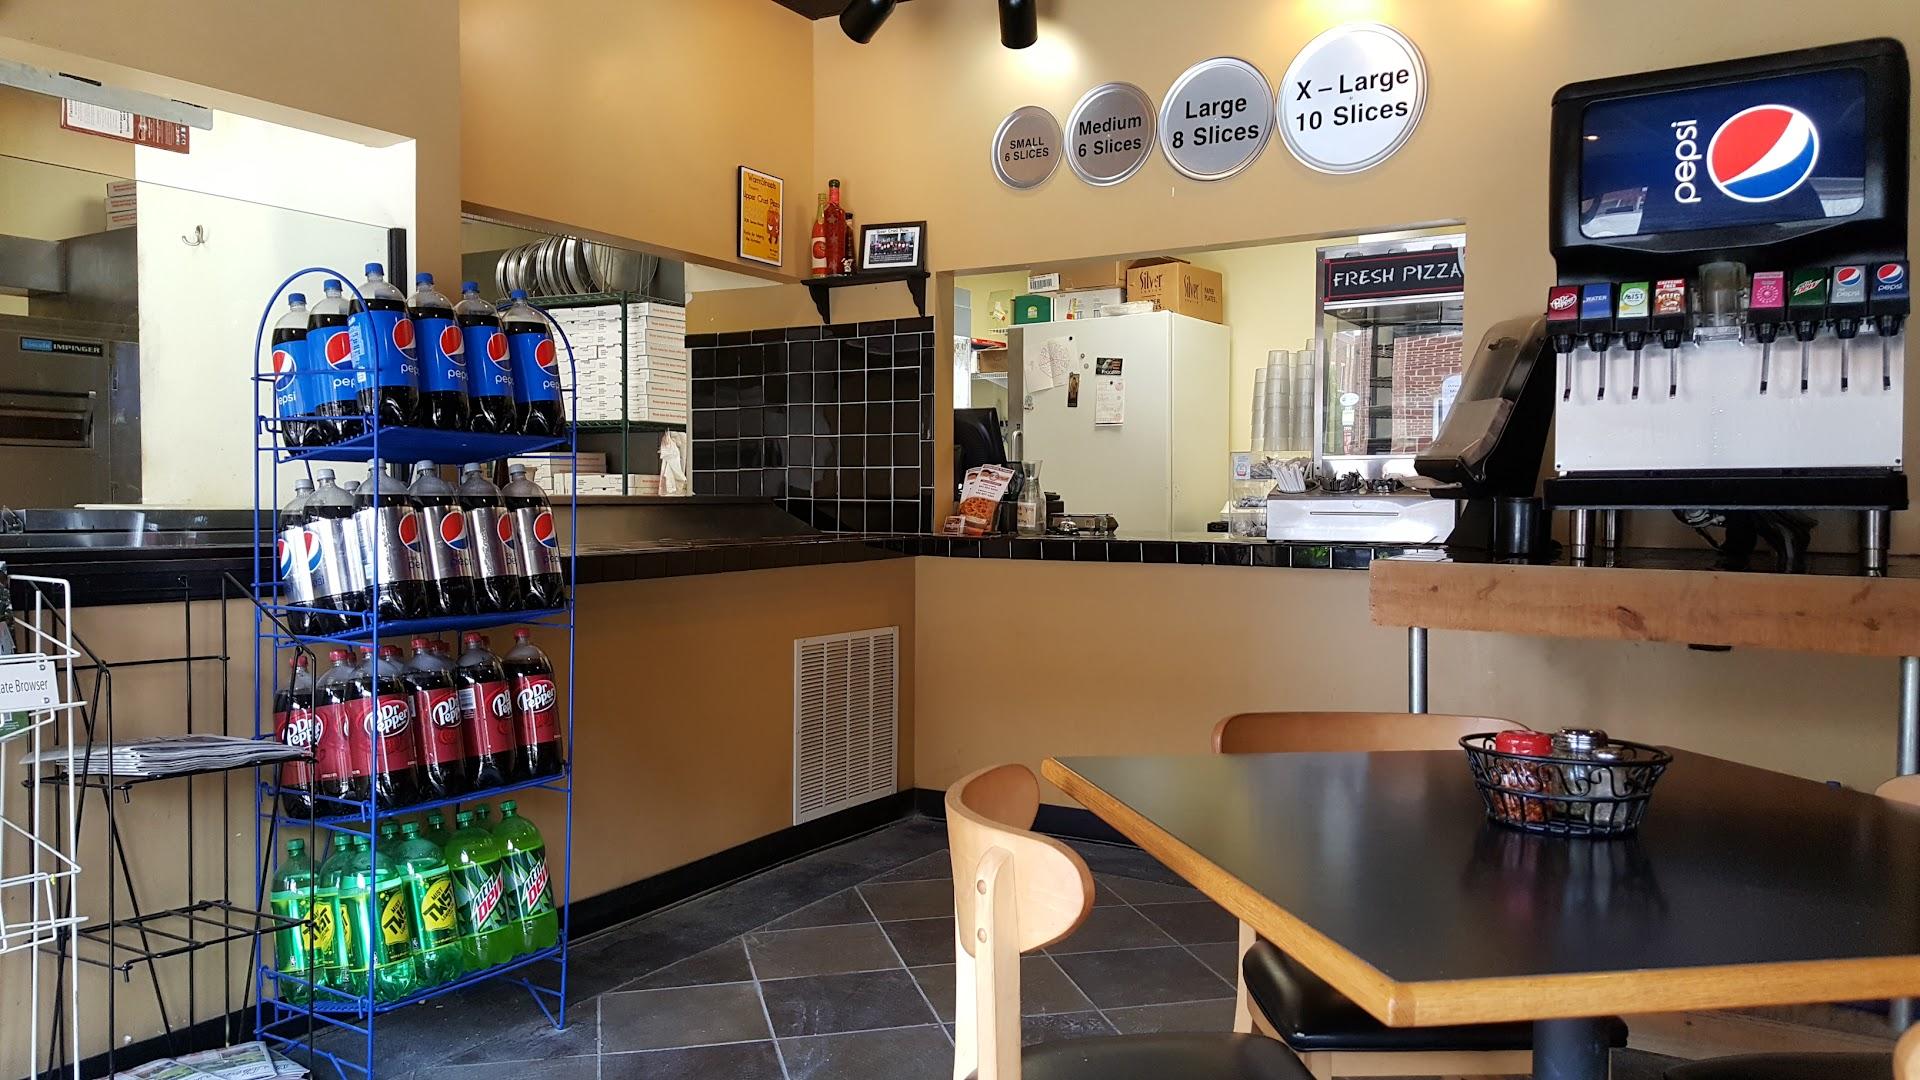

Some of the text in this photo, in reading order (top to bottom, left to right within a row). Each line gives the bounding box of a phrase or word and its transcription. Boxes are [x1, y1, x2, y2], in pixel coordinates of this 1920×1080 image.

[1296, 80, 1312, 101] X
[1339, 68, 1409, 93] Large
[1185, 97, 1247, 120] Large
[1296, 101, 1408, 132] 10 Slices
[1079, 114, 1142, 136] Medium
[1010, 136, 1045, 150] SMALL
[1172, 123, 1259, 149] 8 Slices
[1004, 147, 1049, 162] 6 SLICES
[1078, 136, 1142, 157] 6 Slices
[1671, 120, 1703, 204] pepsi
[1139, 270, 1163, 289] Silver
[1333, 262, 1462, 287] FRESH PIZZA
[1183, 274, 1200, 299] Silver
[1836, 290, 1860, 298] pepsi
[1878, 283, 1903, 292] pepsi
[1657, 293, 1681, 303] MUG
[53, 343, 100, 353] IMPINGER
[278, 391, 296, 406] epsi
[0, 679, 48, 694] ate Browser
[532, 683, 548, 697] Dr
[522, 688, 555, 711] Pepper
[381, 704, 400, 720] Dr
